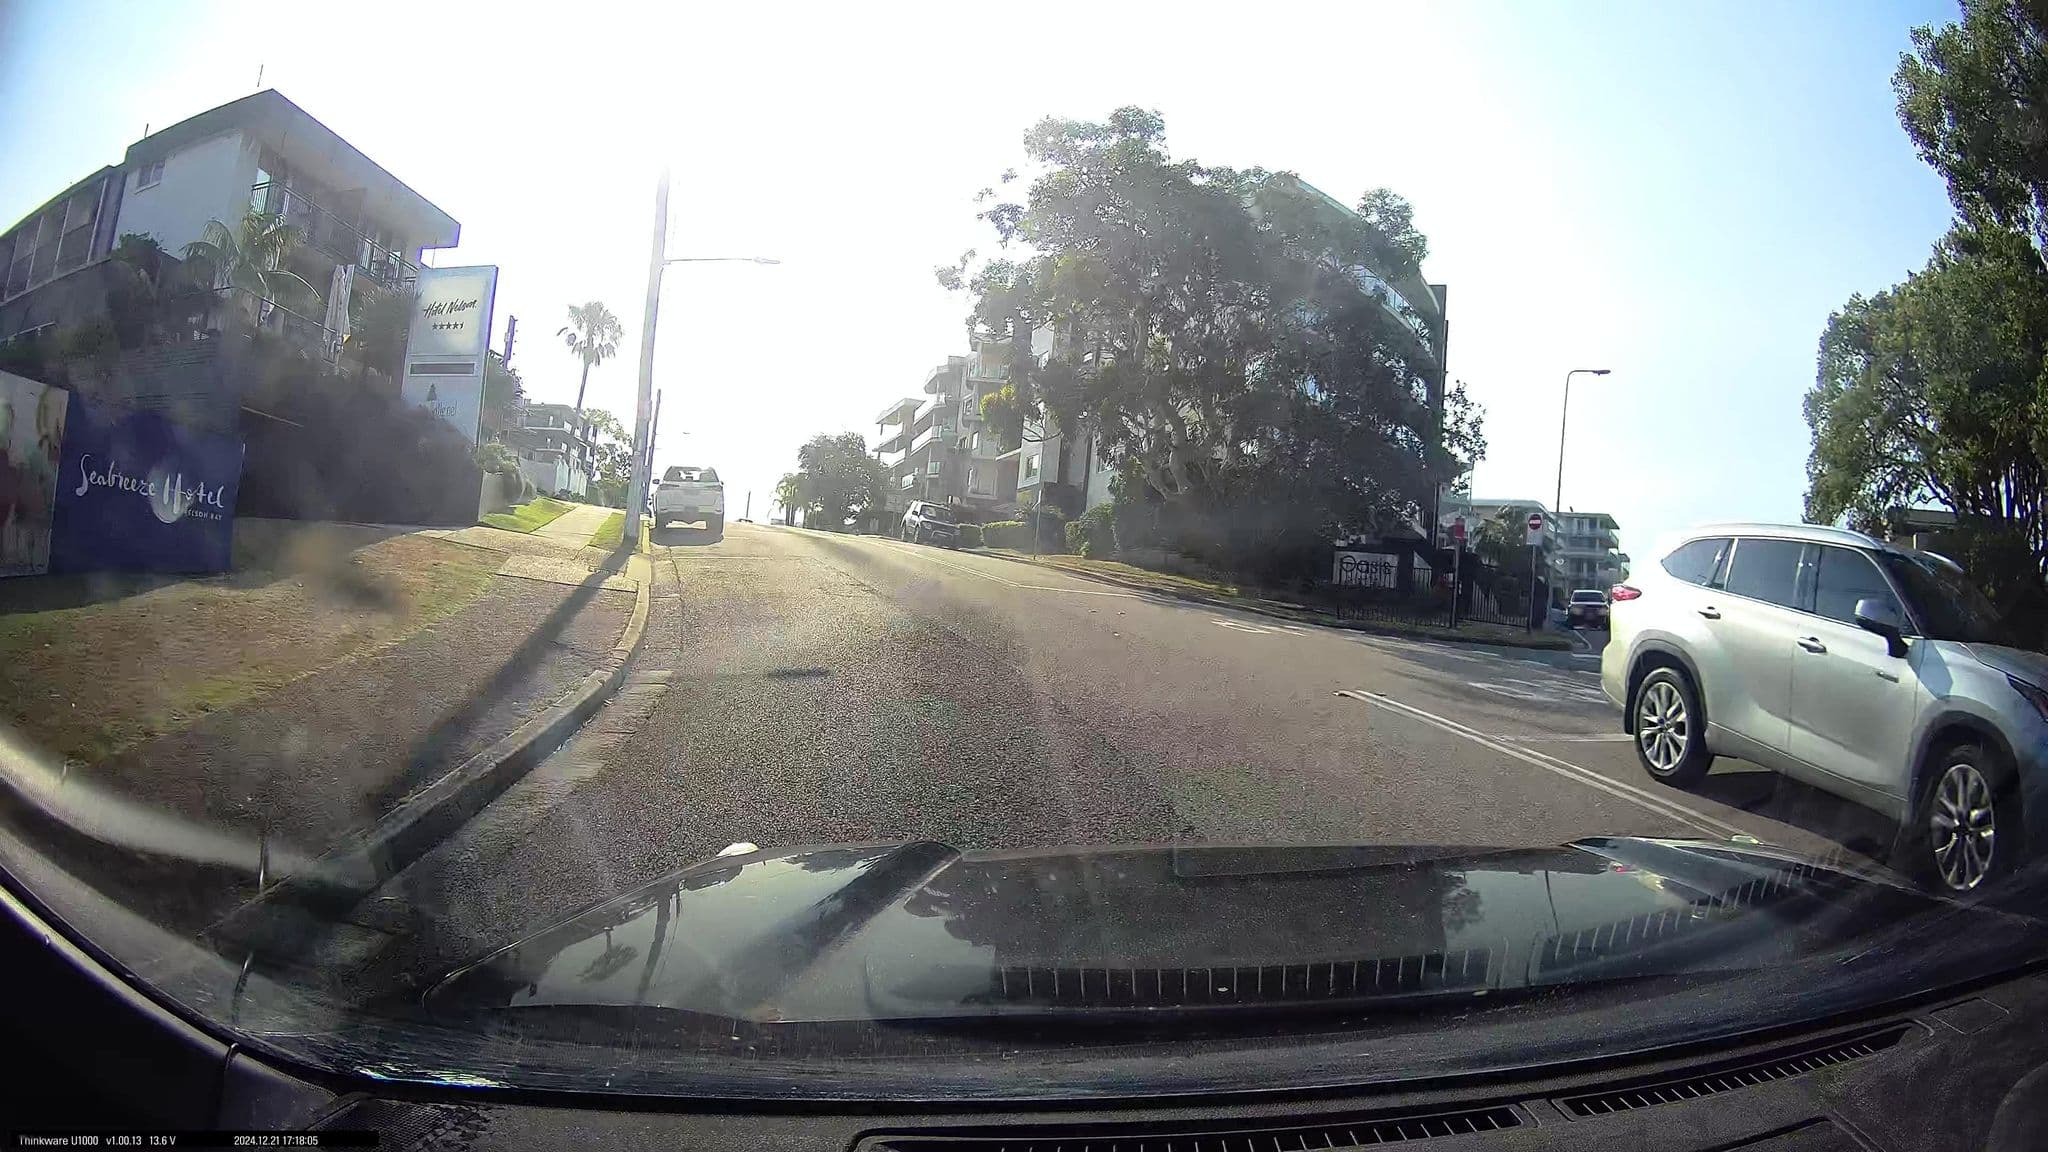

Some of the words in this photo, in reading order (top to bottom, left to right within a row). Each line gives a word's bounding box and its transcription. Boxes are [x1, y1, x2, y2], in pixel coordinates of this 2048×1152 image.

[423, 301, 448, 318] Hotel
[446, 298, 478, 314] Nelson
[75, 454, 156, 496] Seabreeze
[163, 473, 224, 514] Hotel
